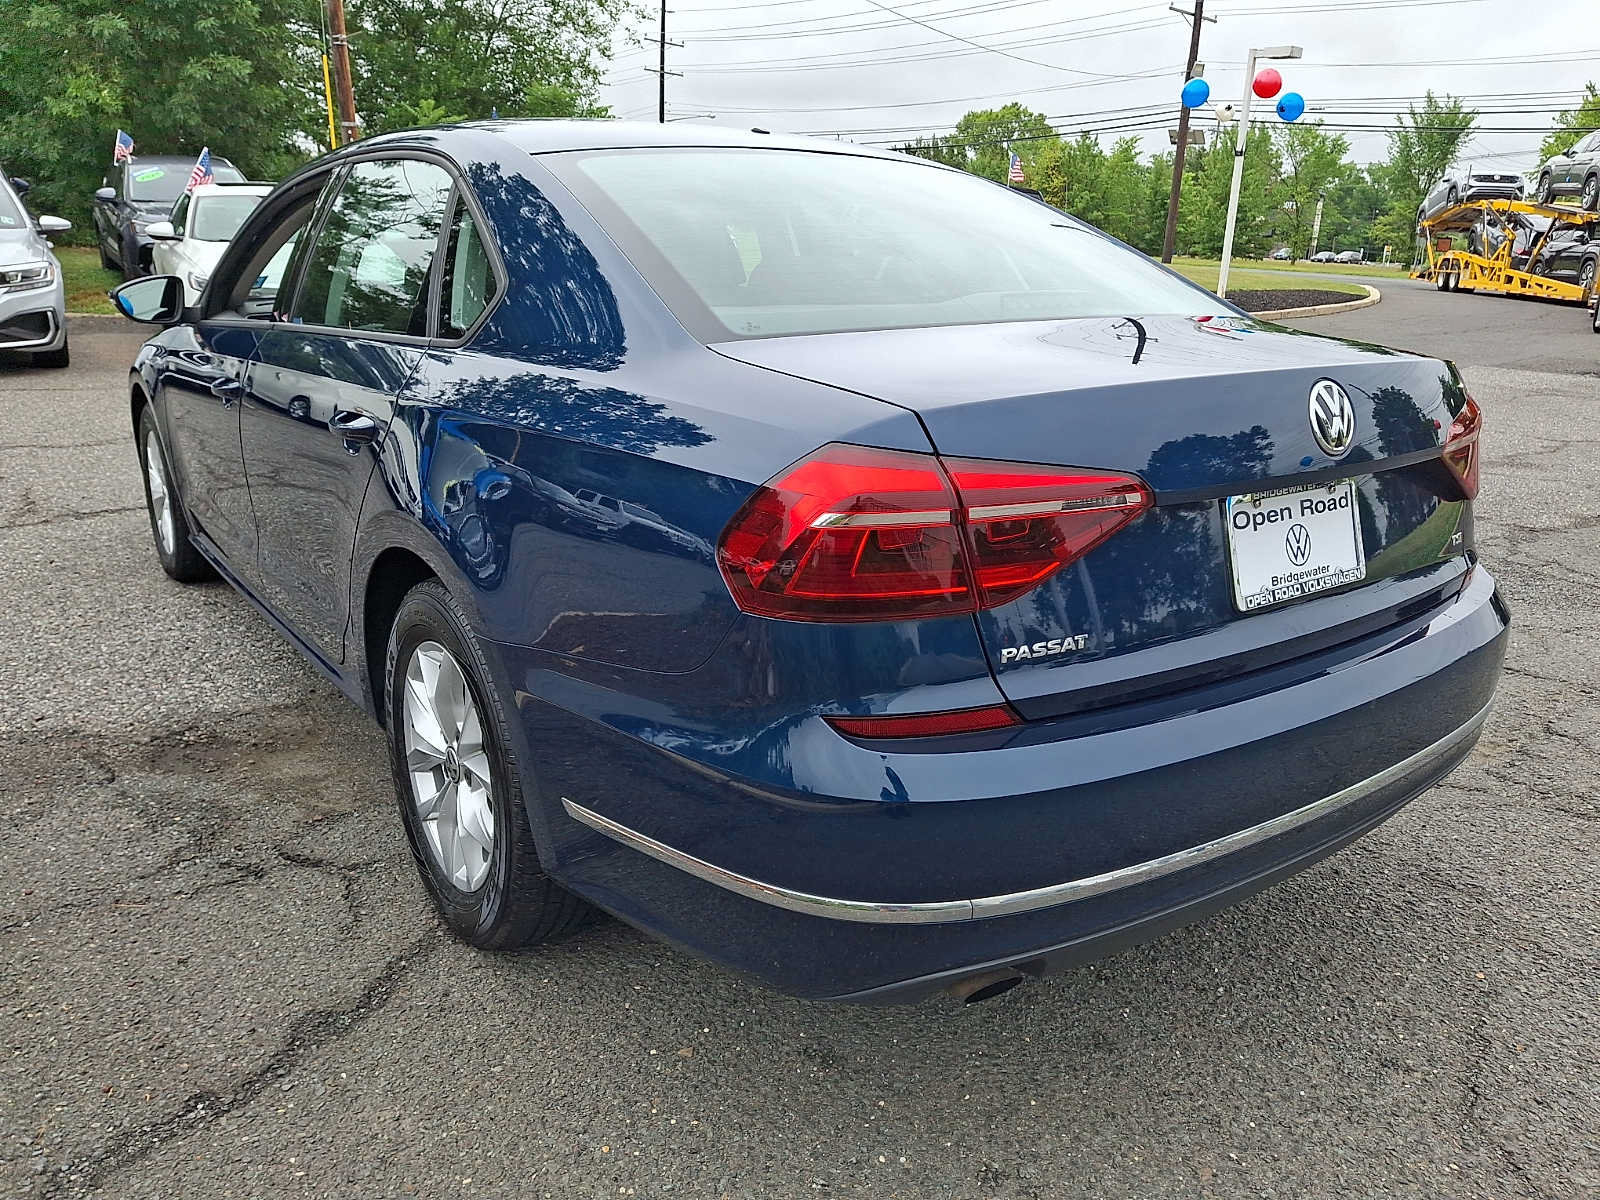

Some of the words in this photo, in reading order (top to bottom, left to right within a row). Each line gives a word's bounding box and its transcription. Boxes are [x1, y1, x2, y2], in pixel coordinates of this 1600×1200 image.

[1233, 506, 1293, 532] Open
[1300, 491, 1350, 518] Road
[1246, 589, 1274, 609] OPEN
[1275, 584, 1302, 601] ROAD
[1302, 567, 1362, 593] VOLKSWAGEN
[1271, 564, 1331, 587] Bridgewater
[1000, 633, 1089, 664] PASSAT
